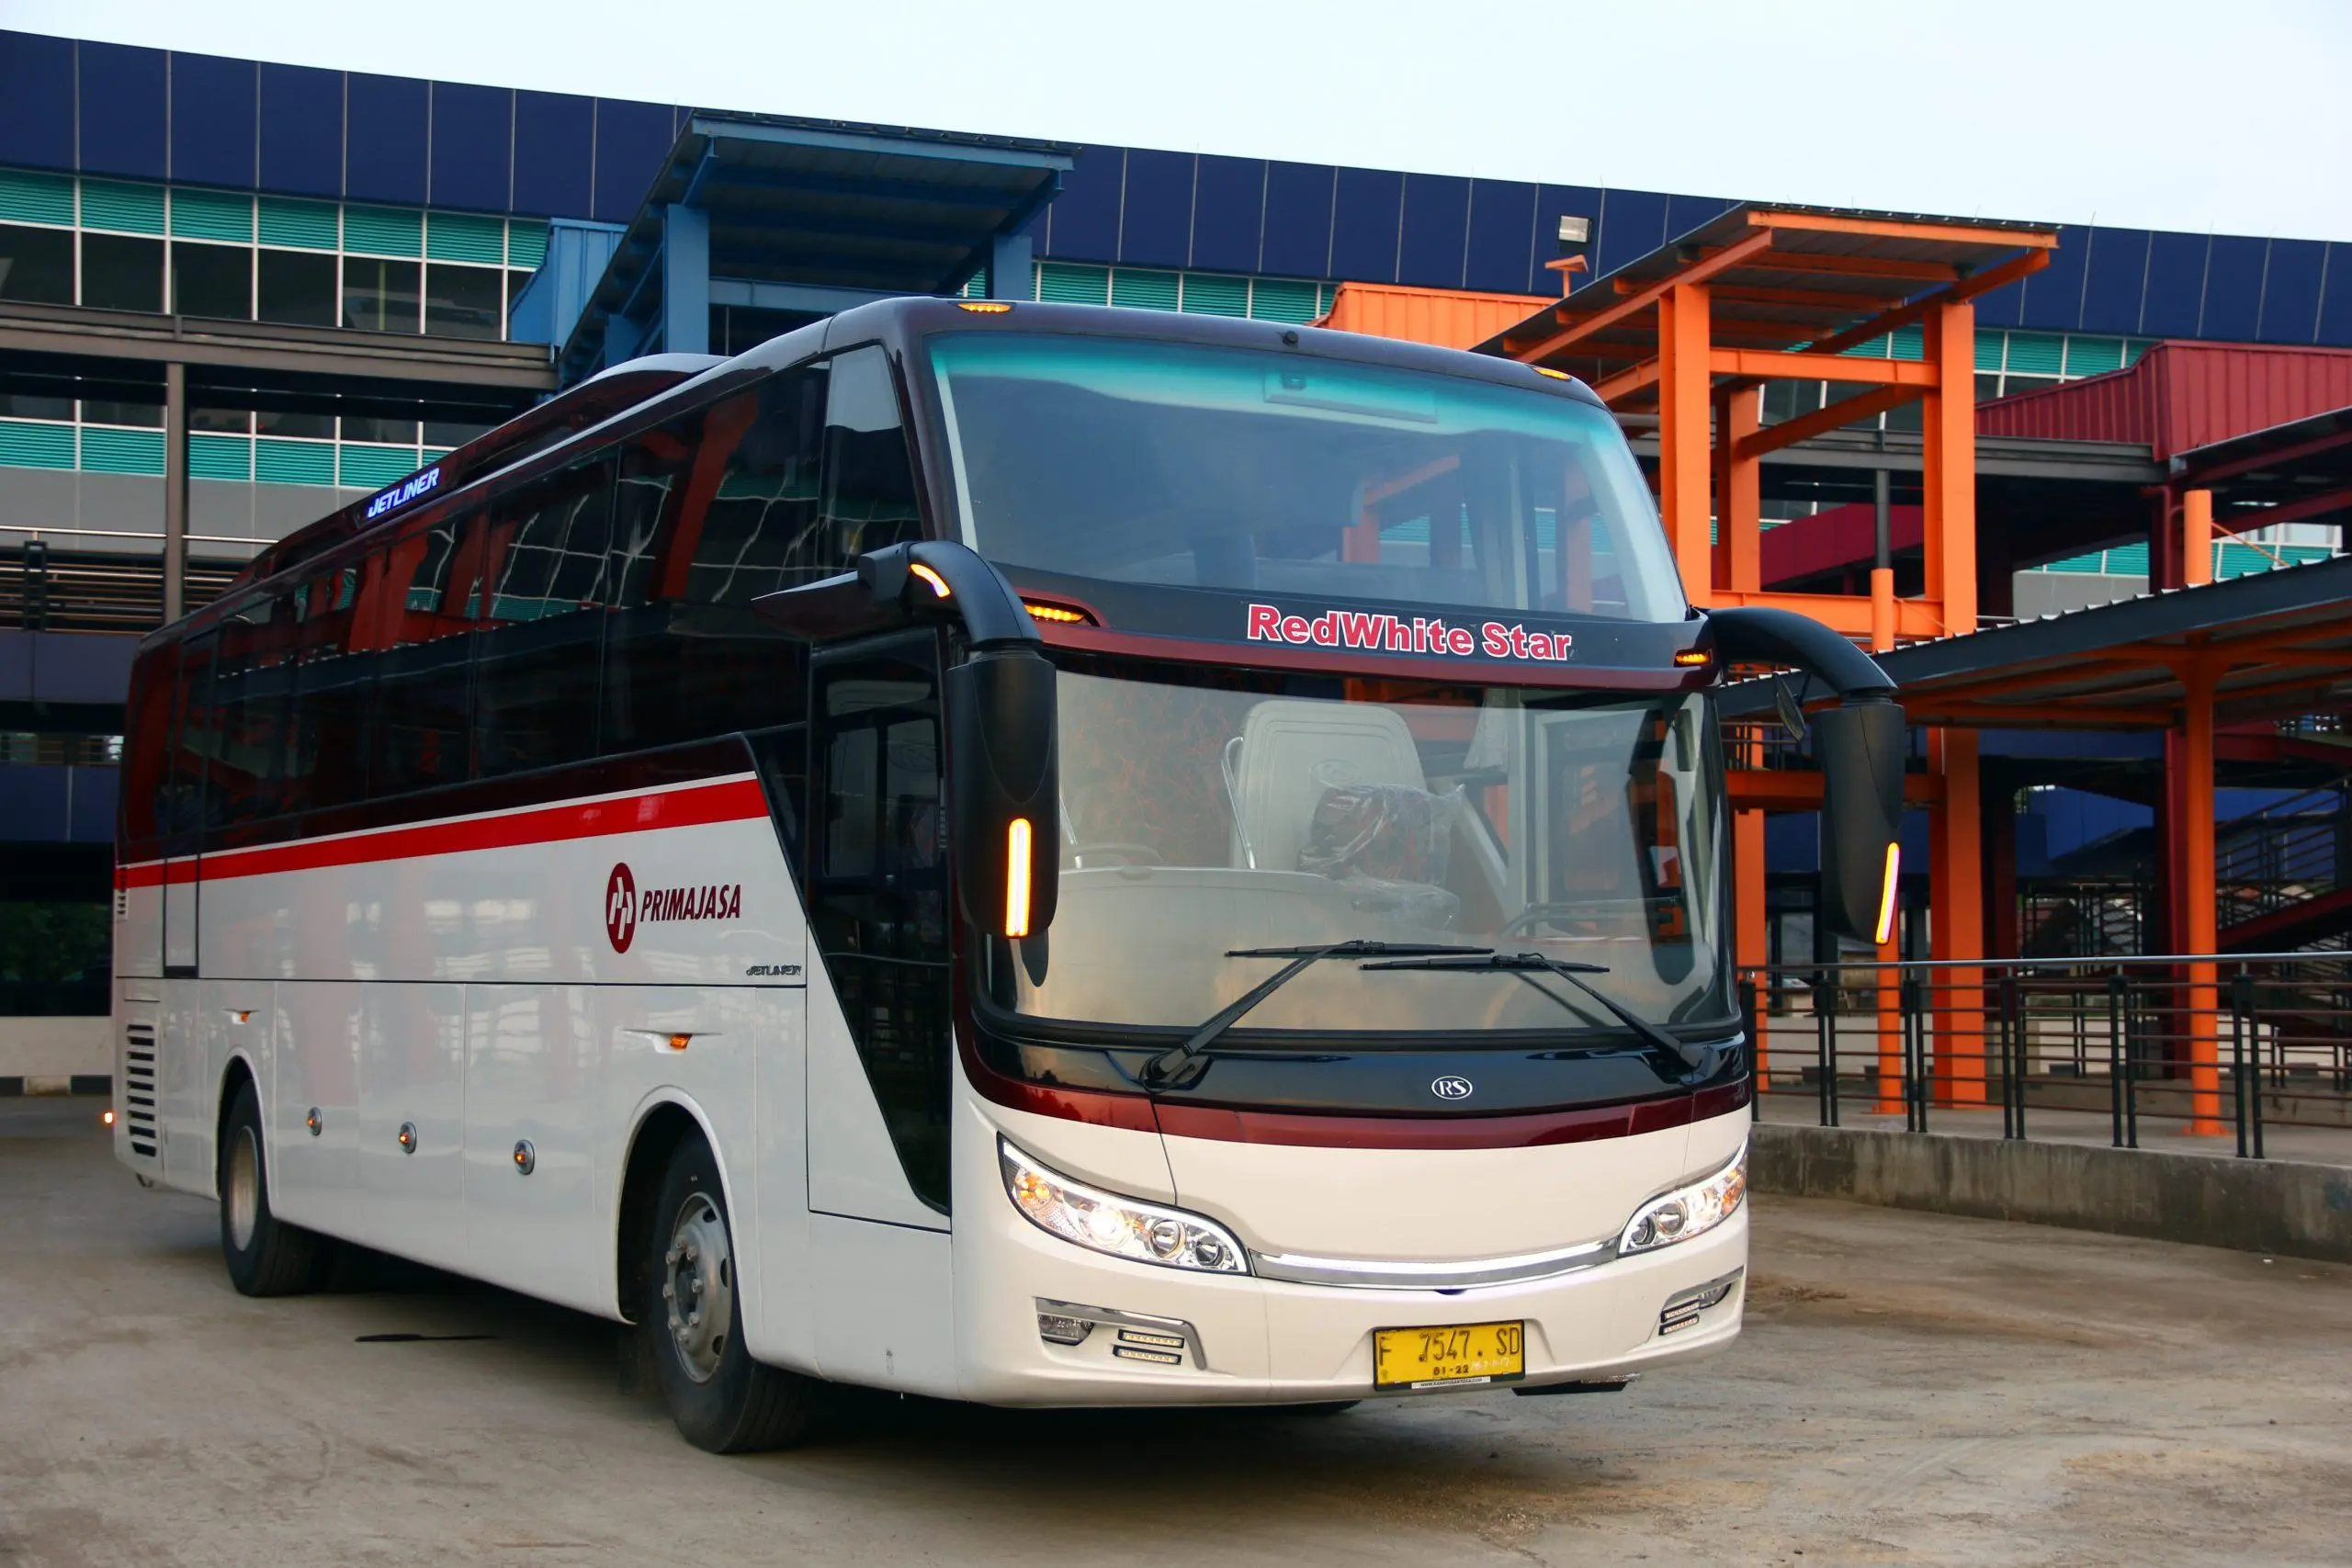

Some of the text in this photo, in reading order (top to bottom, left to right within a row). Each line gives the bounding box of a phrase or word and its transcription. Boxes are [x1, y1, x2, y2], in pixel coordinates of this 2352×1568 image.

[368, 468, 440, 518] JETLINER
[1247, 603, 1572, 661] RedWhite Star
[639, 884, 741, 922] PRIMAJASA
[745, 964, 802, 976] JETLINER
[1439, 1080, 1467, 1096] RS
[1379, 1326, 1521, 1366] F 7547 SD
